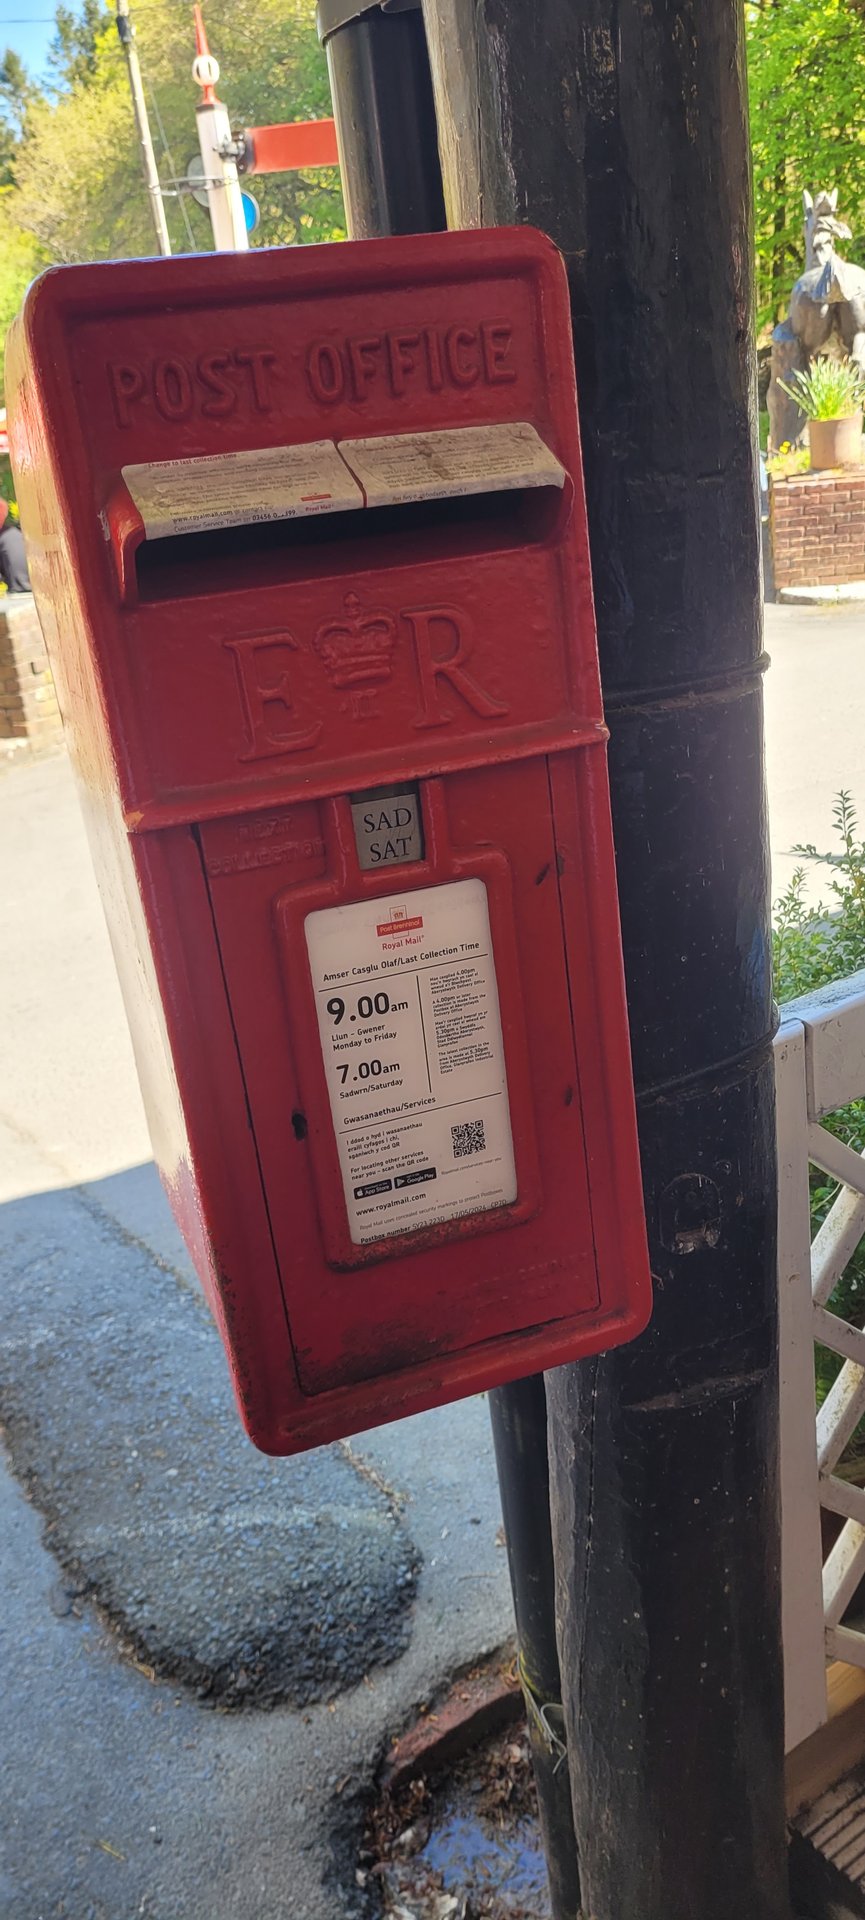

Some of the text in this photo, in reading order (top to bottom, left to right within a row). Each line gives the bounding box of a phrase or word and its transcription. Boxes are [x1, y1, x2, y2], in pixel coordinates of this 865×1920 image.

[107, 320, 518, 430] POST OFFICE
[193, 455, 222, 463] collection
[202, 520, 224, 528] Service
[224, 628, 323, 762] E
[403, 604, 509, 730] R
[363, 808, 412, 832] SAD
[370, 838, 415, 863] SAT
[379, 924, 393, 933] Post
[382, 939, 403, 950] Royal
[323, 942, 479, 982] Amser Casglu Olaf/Last Collection Time
[431, 986, 456, 994] Aberystwyth
[436, 995, 455, 1003] 4.00pm
[454, 999, 479, 1008] Aberystwyth
[326, 992, 408, 1025] 9.00am
[331, 1033, 348, 1042] Llun
[357, 1024, 385, 1036] Gwener
[435, 1027, 455, 1035] 5.30pm
[332, 1040, 362, 1051] Monday
[374, 1031, 397, 1041] Friday
[458, 1044, 477, 1052] collection
[469, 1046, 488, 1054] 5.30pm
[449, 1054, 474, 1063] Aberystwyth
[336, 1059, 400, 1084] 7.00am
[339, 1079, 403, 1099] Sadwrn/Saturday
[343, 1097, 436, 1125] Gwasanaethau/Services
[350, 1136, 365, 1144] ddod
[385, 1123, 422, 1135] wasanaethau
[347, 1144, 362, 1152] eraill
[363, 1139, 385, 1149] cyfagos
[348, 1148, 374, 1160] sganiwch
[361, 1161, 384, 1171] locating
[384, 1156, 400, 1164] other
[401, 1151, 424, 1160] services
[365, 1170, 376, 1178] you
[406, 1173, 424, 1184] Google
[424, 1171, 434, 1180] Play
[365, 1186, 375, 1195] App
[375, 1183, 389, 1192] Store
[355, 1193, 426, 1216] www.royalmail.com
[395, 1210, 418, 1221] concealed
[418, 1206, 436, 1214] security
[360, 1231, 384, 1244] Postbox
[386, 1225, 410, 1236] number
